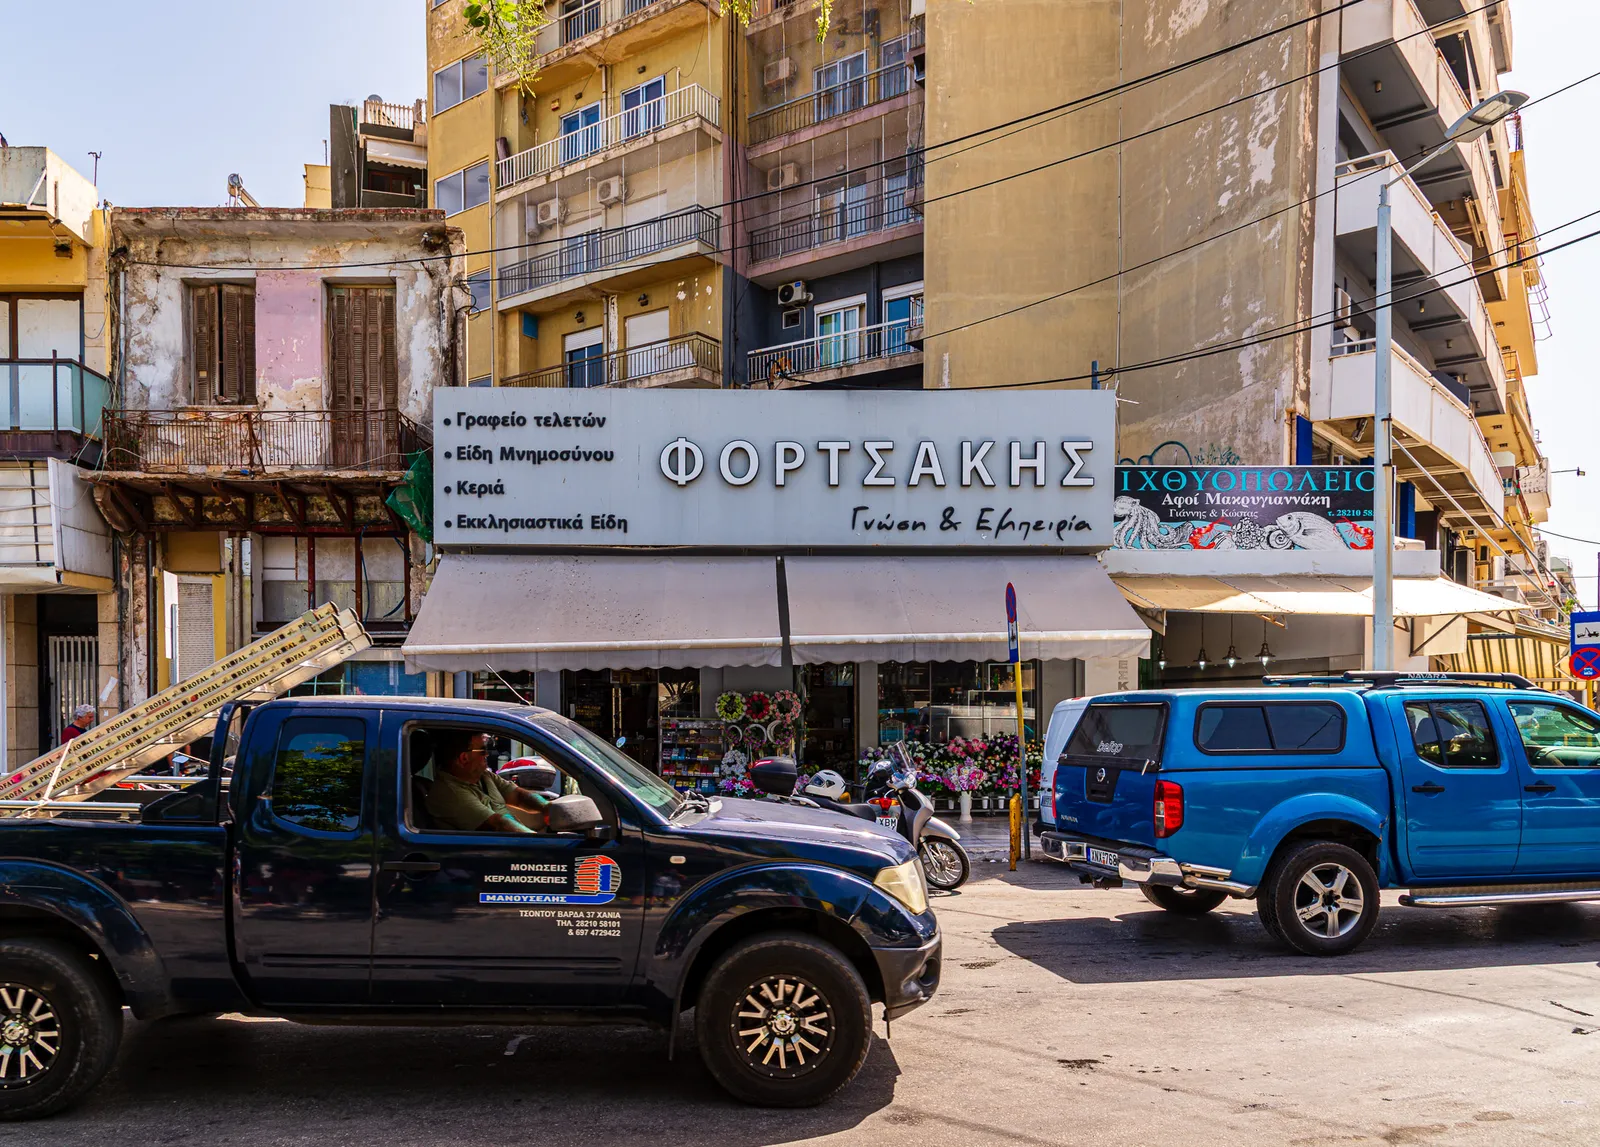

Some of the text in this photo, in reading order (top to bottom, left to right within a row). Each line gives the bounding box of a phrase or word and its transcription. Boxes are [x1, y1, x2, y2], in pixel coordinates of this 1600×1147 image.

[457, 411, 606, 430] Γραφείο τελετών
[456, 445, 615, 465] Είδη Μνημοσύνου
[659, 436, 1095, 487] ΦΟΡΤΣΑΚΗΣ
[456, 479, 505, 497] Κεριά
[1121, 470, 1375, 492] ΙΧΘΥΟΠΩΛΕΙΟ
[1161, 492, 1331, 508] Αφοί Μακρυγιαννάκη
[1169, 508, 1259, 519] Γιάννης & Κώστας
[1336, 509, 1361, 517] 28210
[1363, 509, 1375, 517] 58
[456, 512, 628, 533] Εκκλησιαστικά Είδη
[851, 506, 1093, 541] Γνώση & Εμπειρία
[105, 717, 132, 733] PROFAL
[144, 696, 171, 712] PROFAL
[221, 655, 248, 671] PRFAL
[155, 704, 182, 721] PROFAL
[231, 662, 259, 679] ROFAL
[86, 755, 113, 771] ROFAL
[203, 692, 230, 709] PROFAL
[242, 671, 269, 688] PROFAL
[510, 863, 568, 872] ΜΟΝΩΣΕΙΣ
[484, 875, 568, 884] ΚΕΡΑΜΟΣΚΕΠΕΣ
[486, 894, 567, 903] ΜΑΝΟΥΣΕΛΗΣ
[519, 910, 621, 919] ΤΣΟΝΤΟΥ ΒΑΡΔΑ 37 ΧΑΝΙΑ
[598, 920, 621, 928] 58101
